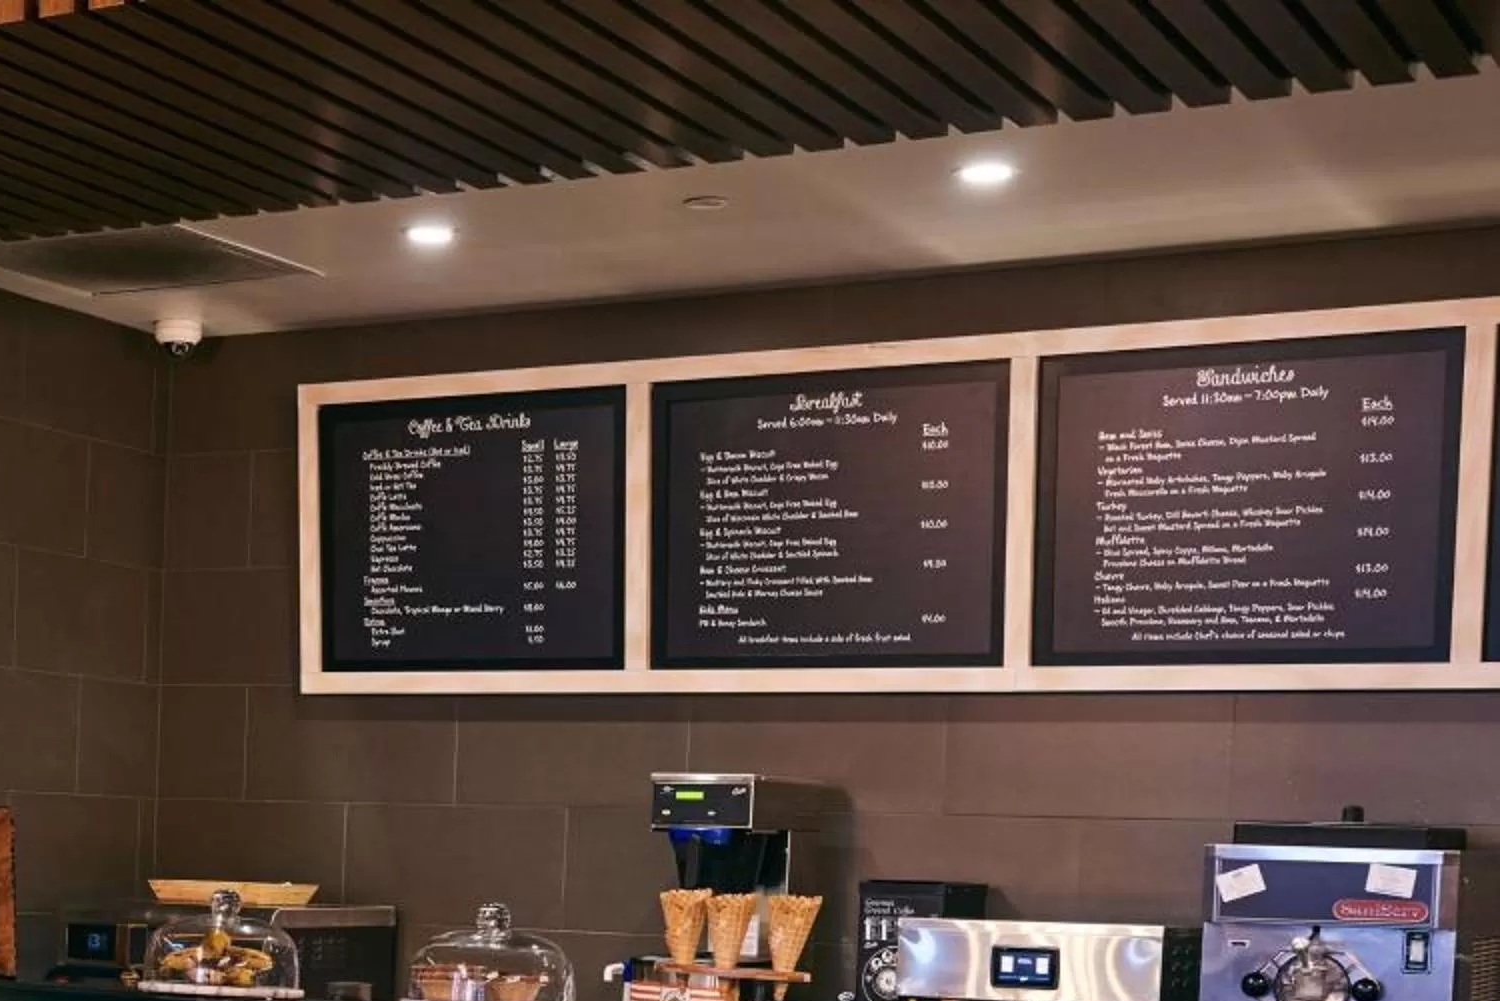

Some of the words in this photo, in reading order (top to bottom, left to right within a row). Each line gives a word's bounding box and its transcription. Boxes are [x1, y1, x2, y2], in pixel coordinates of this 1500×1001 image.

[1196, 365, 1295, 387] Sandwiches
[789, 391, 862, 414] Breakfast
[1163, 392, 1198, 407] Served
[1301, 386, 1328, 400] Daily
[1361, 395, 1393, 412] Each
[407, 418, 443, 439] Coffee
[486, 412, 531, 431] Drinks
[922, 421, 948, 437] Each
[1096, 502, 1127, 513] Turkey
